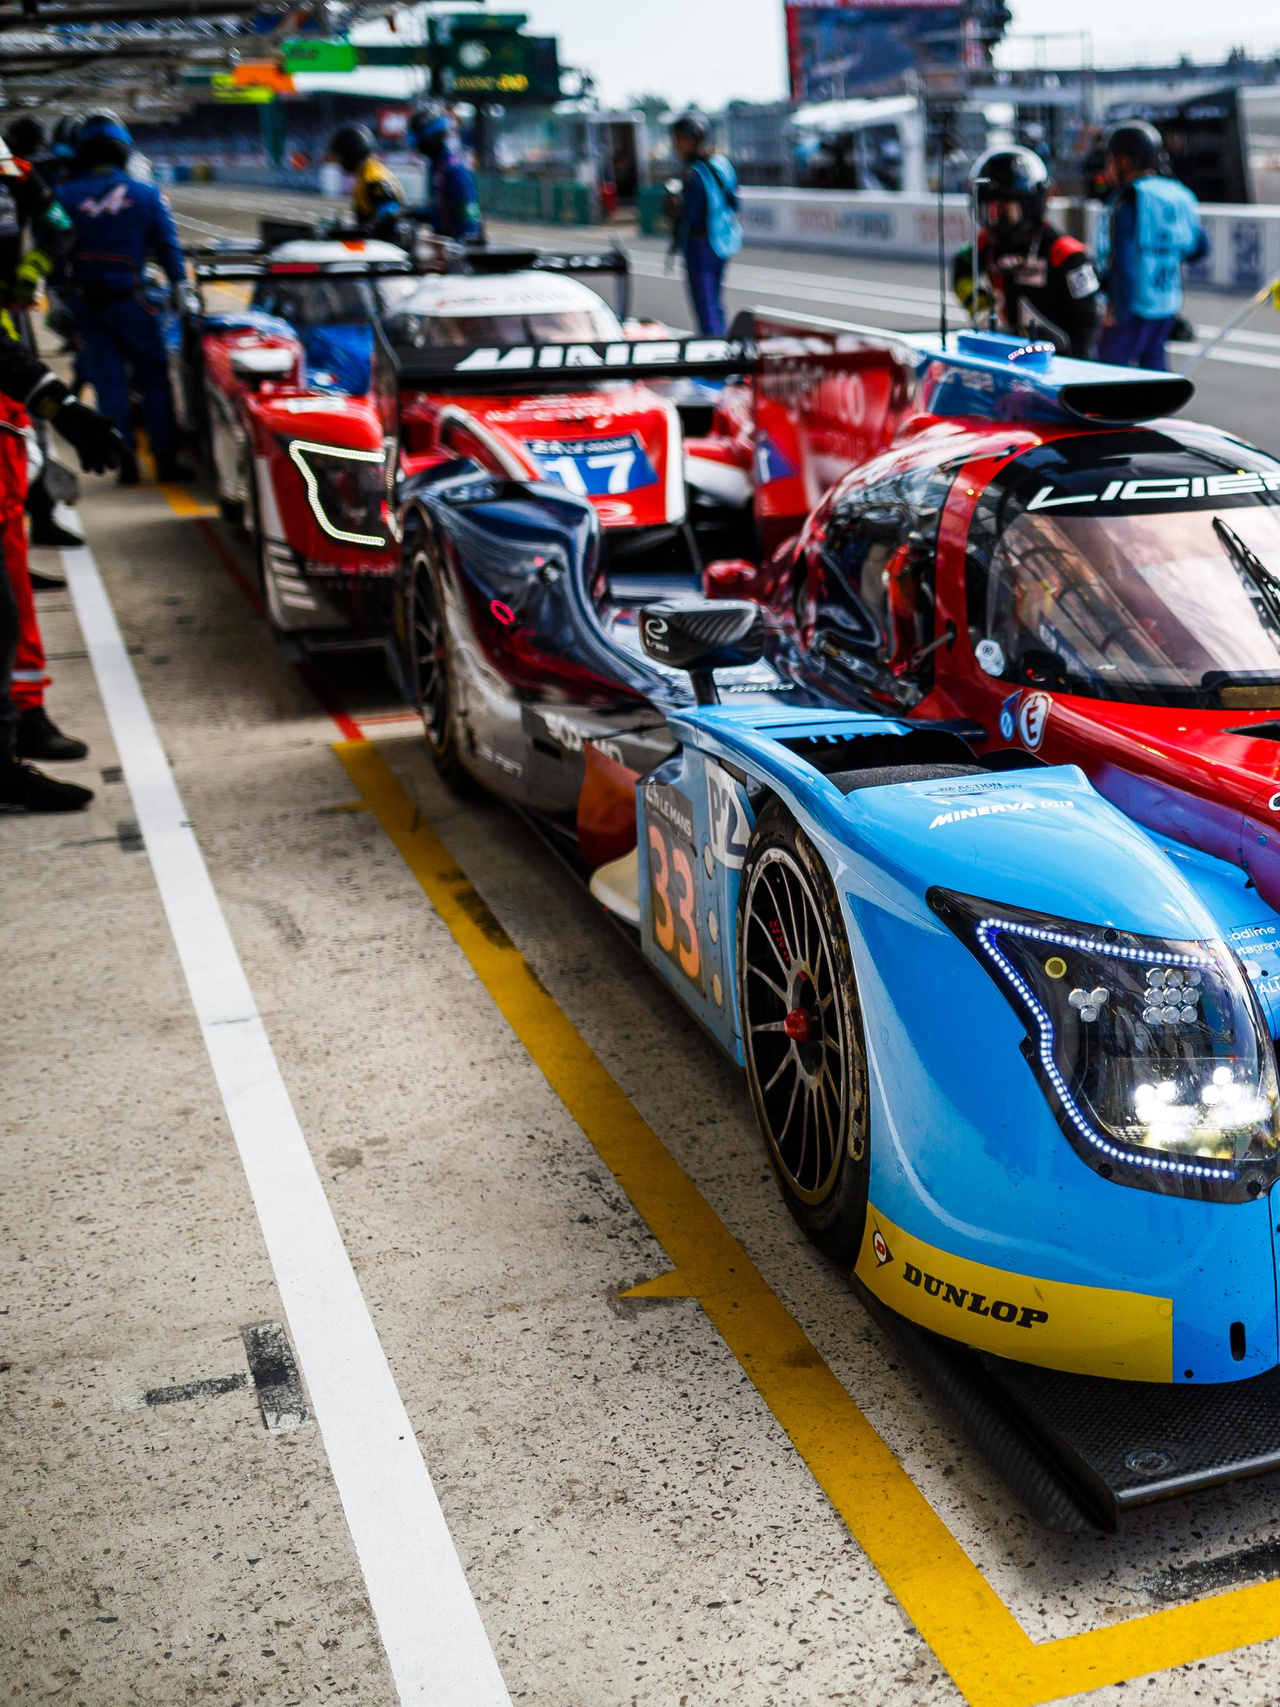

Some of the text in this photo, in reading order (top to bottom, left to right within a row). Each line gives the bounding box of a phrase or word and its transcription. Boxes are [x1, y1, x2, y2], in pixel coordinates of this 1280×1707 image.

[543, 450, 635, 496] 17
[708, 775, 747, 857] P2
[929, 801, 1036, 829] MINERVA
[649, 825, 699, 978] 33
[902, 1262, 1049, 1329] DUNLOP
